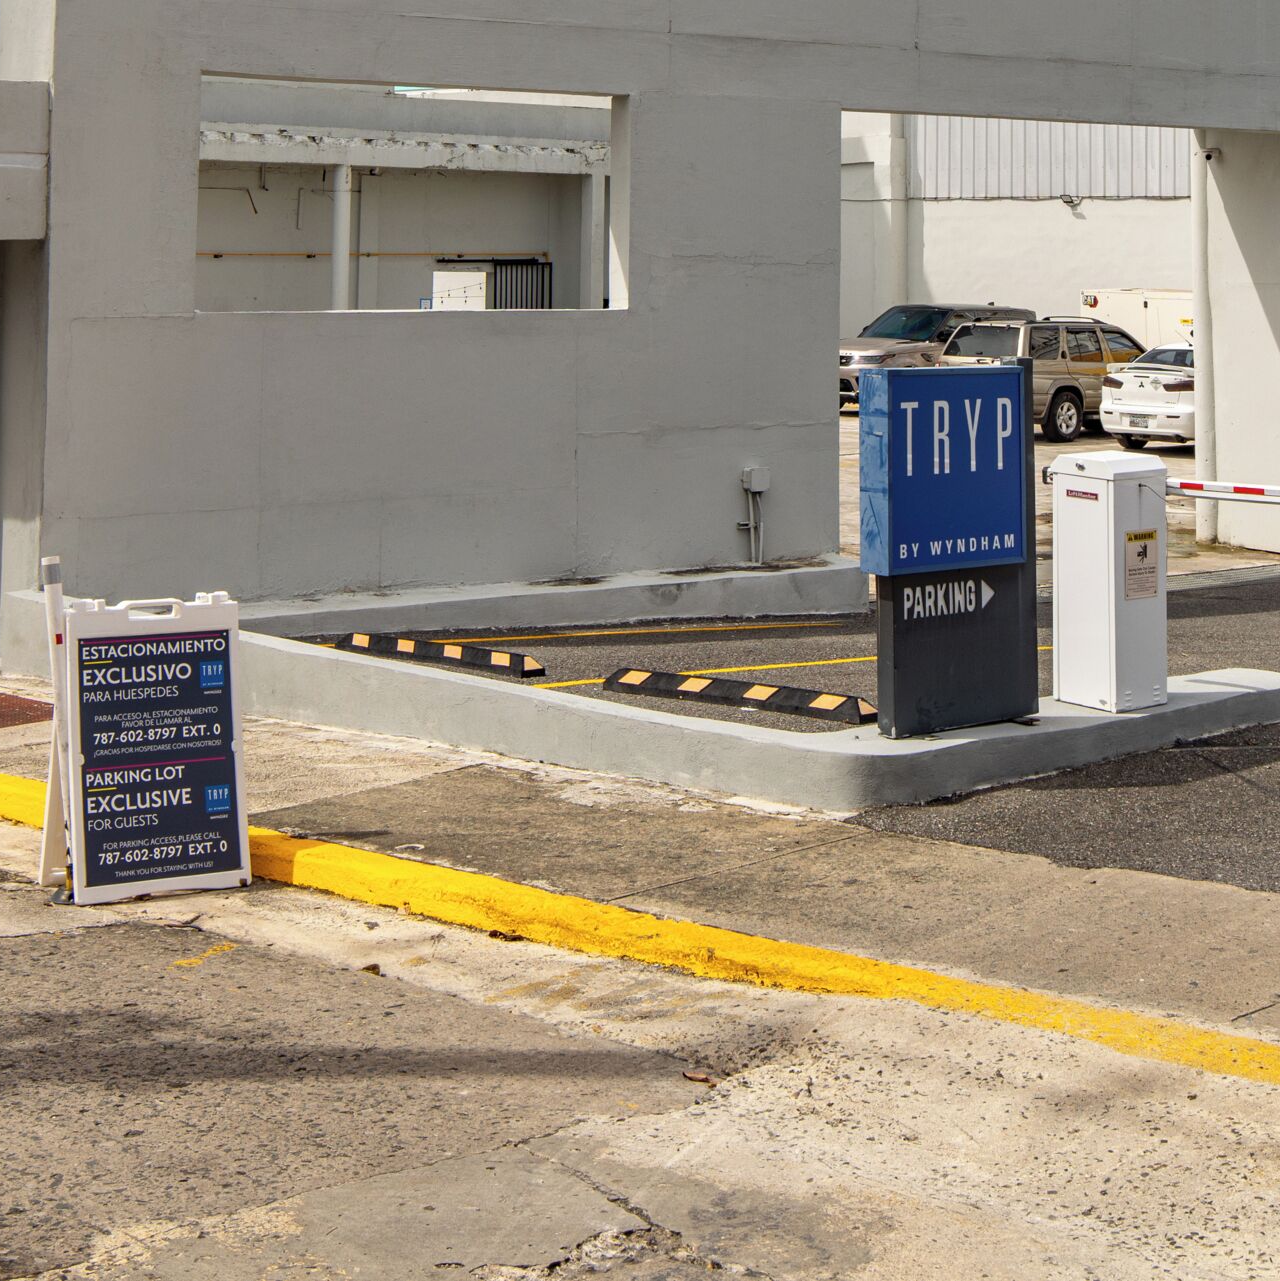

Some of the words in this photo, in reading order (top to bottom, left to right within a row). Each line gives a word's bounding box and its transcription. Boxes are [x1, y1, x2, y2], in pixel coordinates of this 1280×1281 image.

[900, 397, 1013, 477] TRYP
[899, 543, 919, 559] BY
[930, 533, 1015, 556] WYNDHAM
[903, 579, 976, 620] PARKING
[82, 638, 225, 660] ESTACIONAMIENTO
[82, 663, 192, 686] EXCLUSIVO
[83, 691, 112, 703] PARA
[114, 685, 179, 701] HUESPEDES
[94, 714, 113, 723] PARA
[113, 711, 142, 721] ACCESO
[143, 711, 151, 719] AL
[152, 706, 218, 718] ESTACIONAMIENTO
[121, 719, 144, 728] FAVOR
[145, 719, 154, 727] DE
[156, 717, 183, 726] LLAMAR
[93, 727, 177, 745] 787-602-8797
[182, 724, 210, 738] EXT.
[213, 723, 221, 735] 0
[121, 745, 134, 754] POR
[134, 742, 172, 753] HOSPEDARSE
[172, 741, 187, 750] CON
[86, 768, 152, 787] PARKING
[155, 765, 185, 780] LOT
[86, 787, 192, 814] EXCLUSIVE
[87, 818, 112, 832] FOR
[114, 814, 159, 829] GUESTS
[103, 842, 118, 851] FOR
[119, 839, 150, 849] PARKING
[203, 831, 221, 839] CALL
[98, 845, 183, 866] 787-602-8797
[188, 842, 217, 856] EXT.
[220, 840, 228, 852] 0
[115, 869, 136, 878] THANK
[136, 867, 150, 876] YOU
[150, 866, 163, 874] FOR
[163, 863, 188, 873] STAYING
[188, 861, 204, 870] WITH
